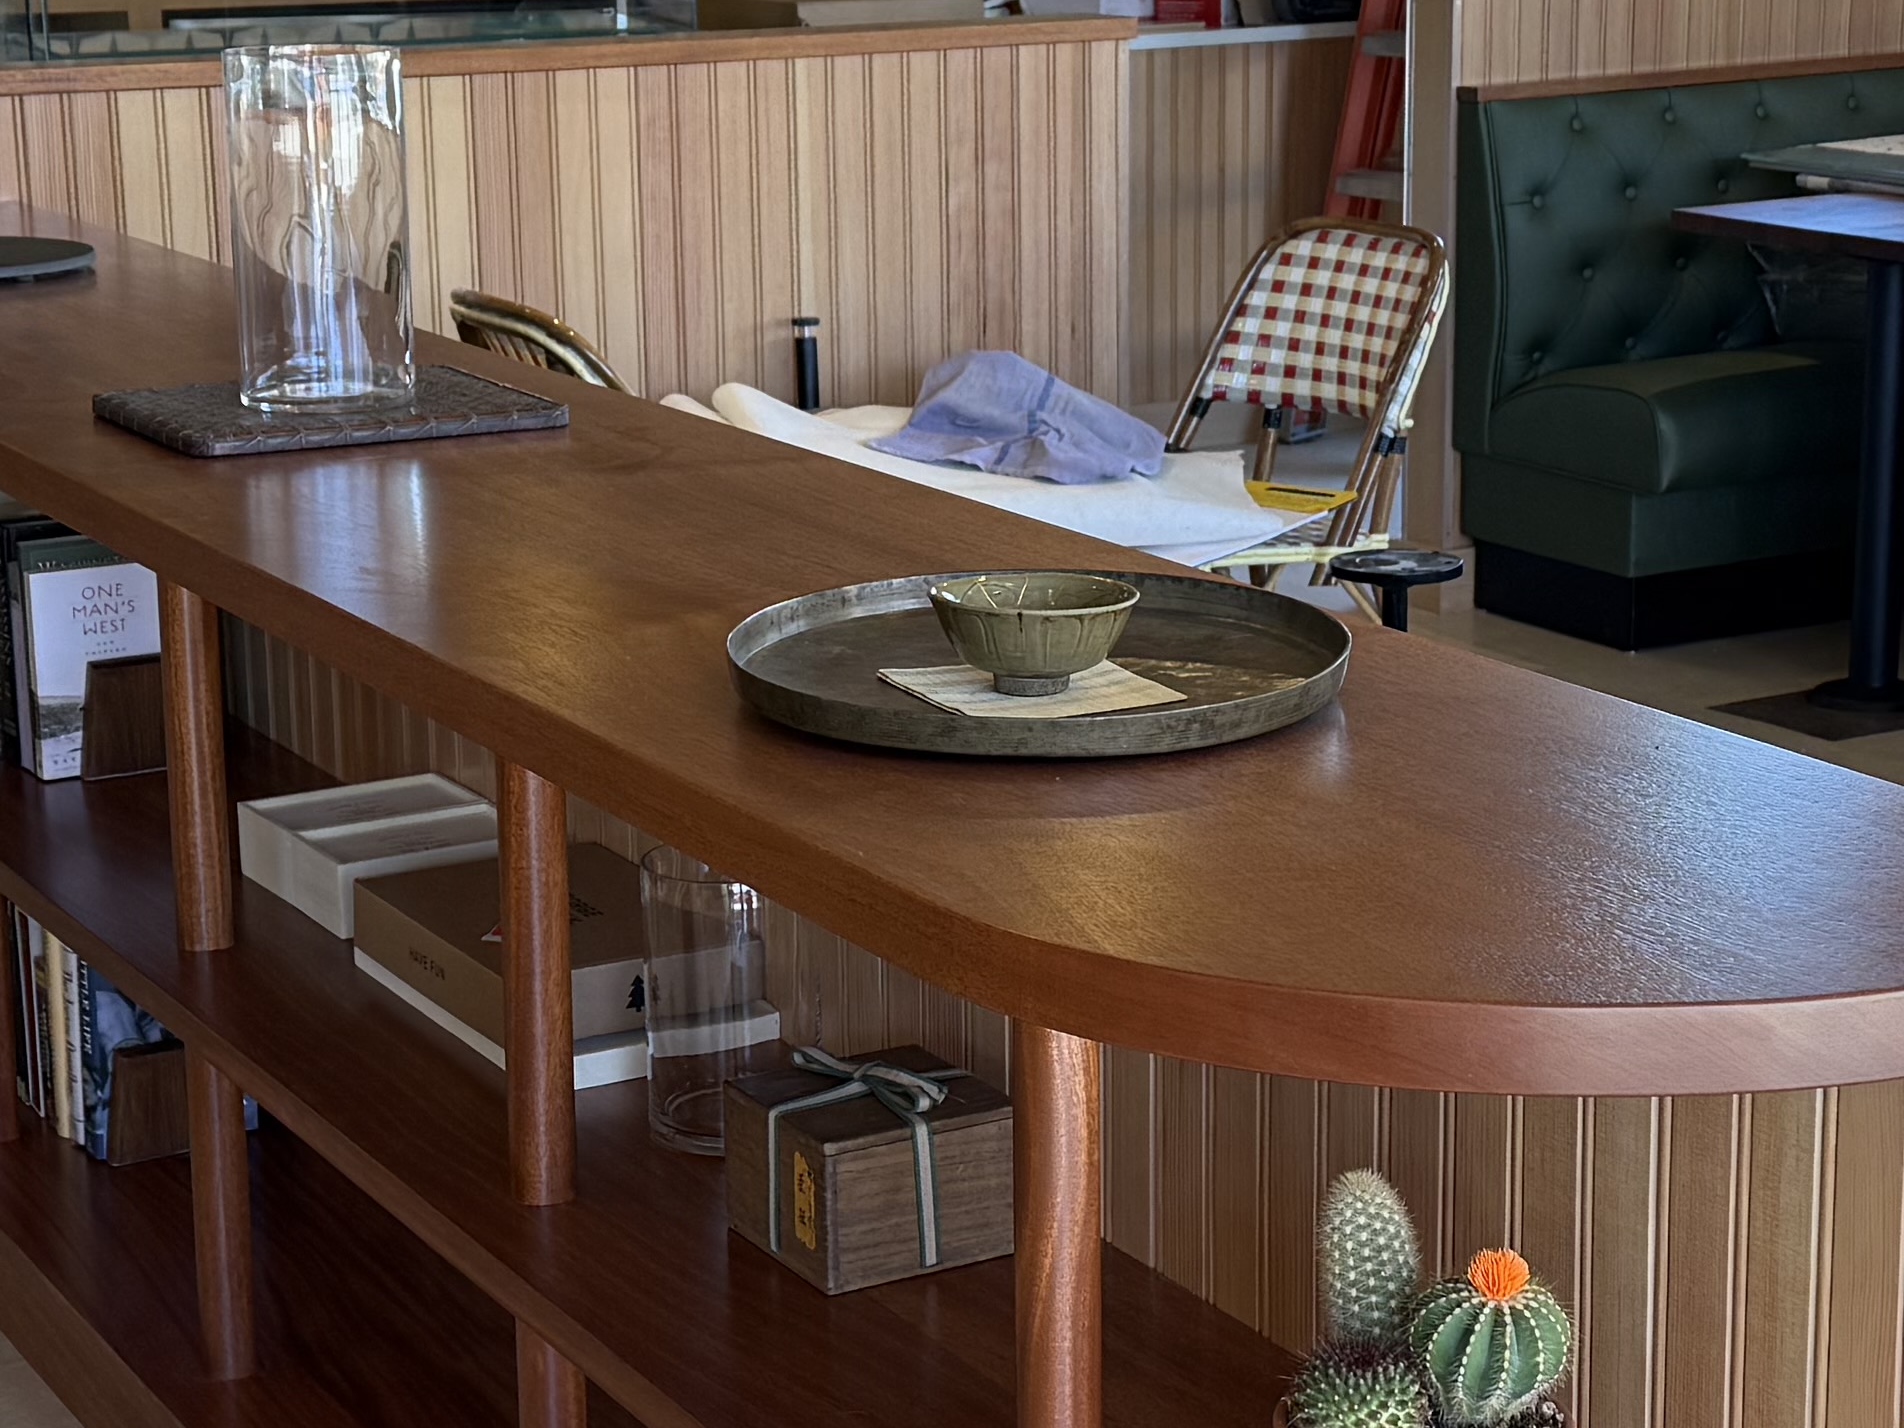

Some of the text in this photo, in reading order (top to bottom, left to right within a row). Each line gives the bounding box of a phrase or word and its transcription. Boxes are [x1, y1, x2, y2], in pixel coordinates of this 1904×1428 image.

[81, 582, 124, 601] ONE
[72, 598, 136, 620] MAN'S
[82, 617, 127, 636] WEST
[409, 948, 428, 970] HAVE
